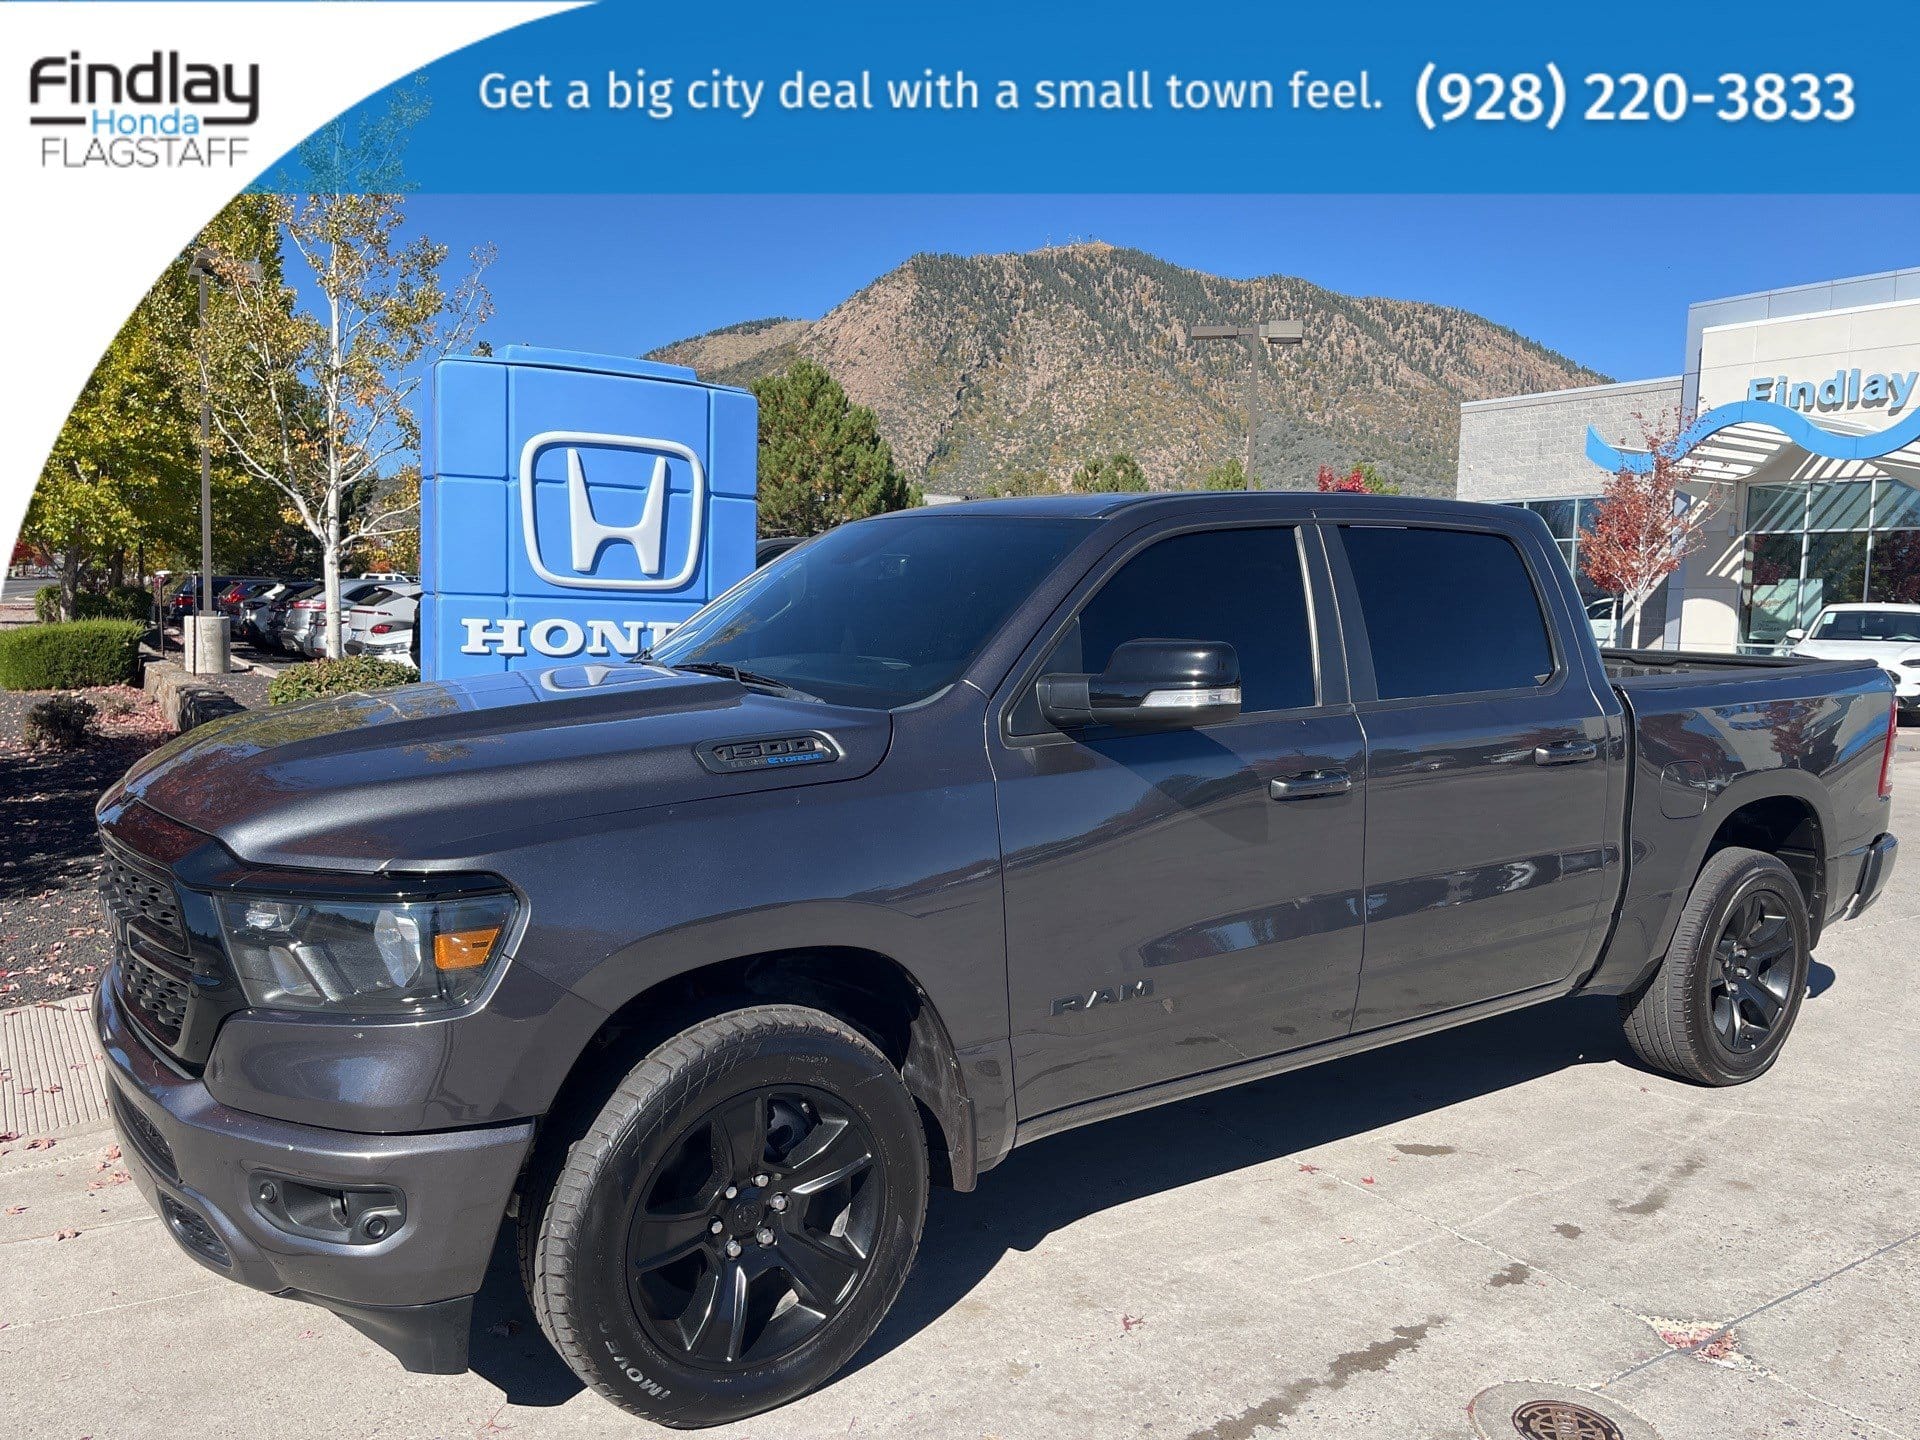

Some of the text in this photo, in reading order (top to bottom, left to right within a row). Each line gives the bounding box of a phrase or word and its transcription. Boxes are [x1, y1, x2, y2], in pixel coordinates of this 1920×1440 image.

[1748, 368, 1920, 413] Findlay
[713, 736, 817, 760] 1500
[1050, 978, 1155, 1016] RAM
